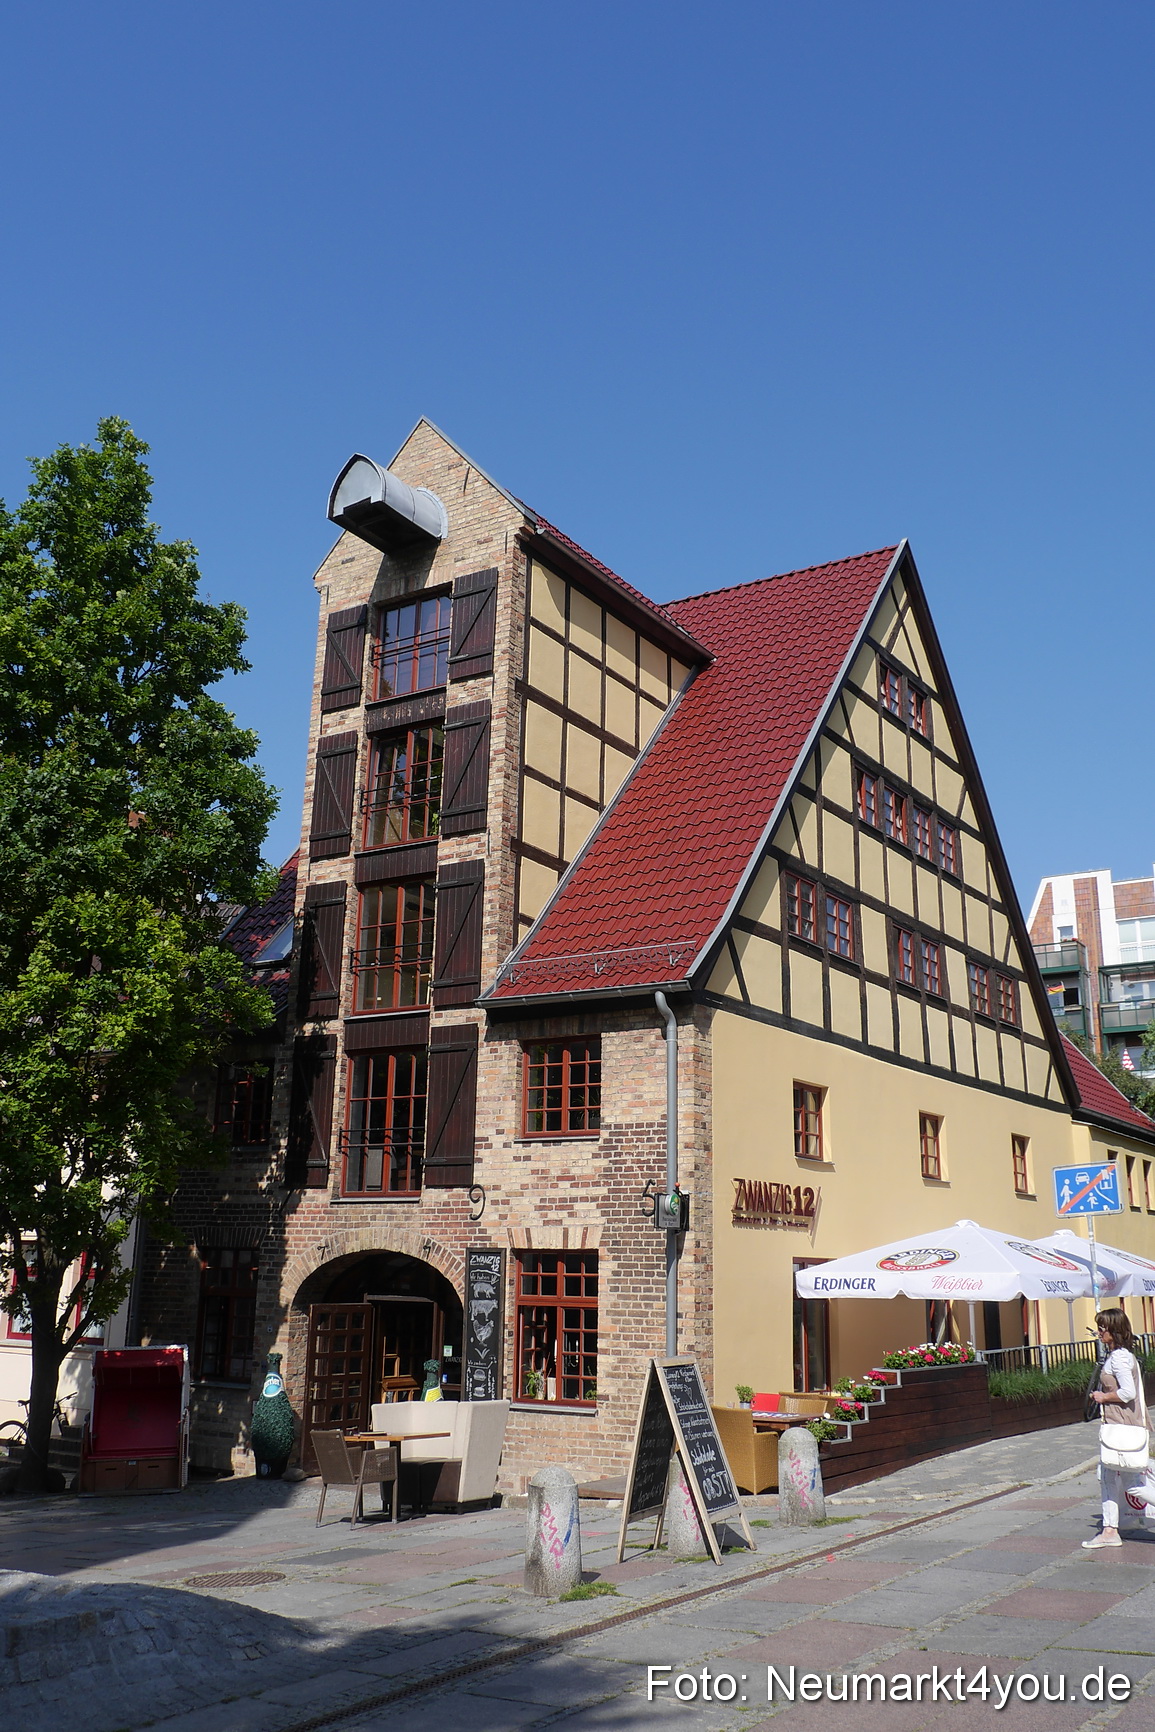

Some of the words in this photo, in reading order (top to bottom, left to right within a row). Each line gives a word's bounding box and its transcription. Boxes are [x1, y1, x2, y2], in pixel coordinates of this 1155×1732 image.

[889, 1248, 956, 1260] ERDINGER
[814, 1276, 876, 1292] ERDINGER
[932, 1275, 983, 1294] Weißbier
